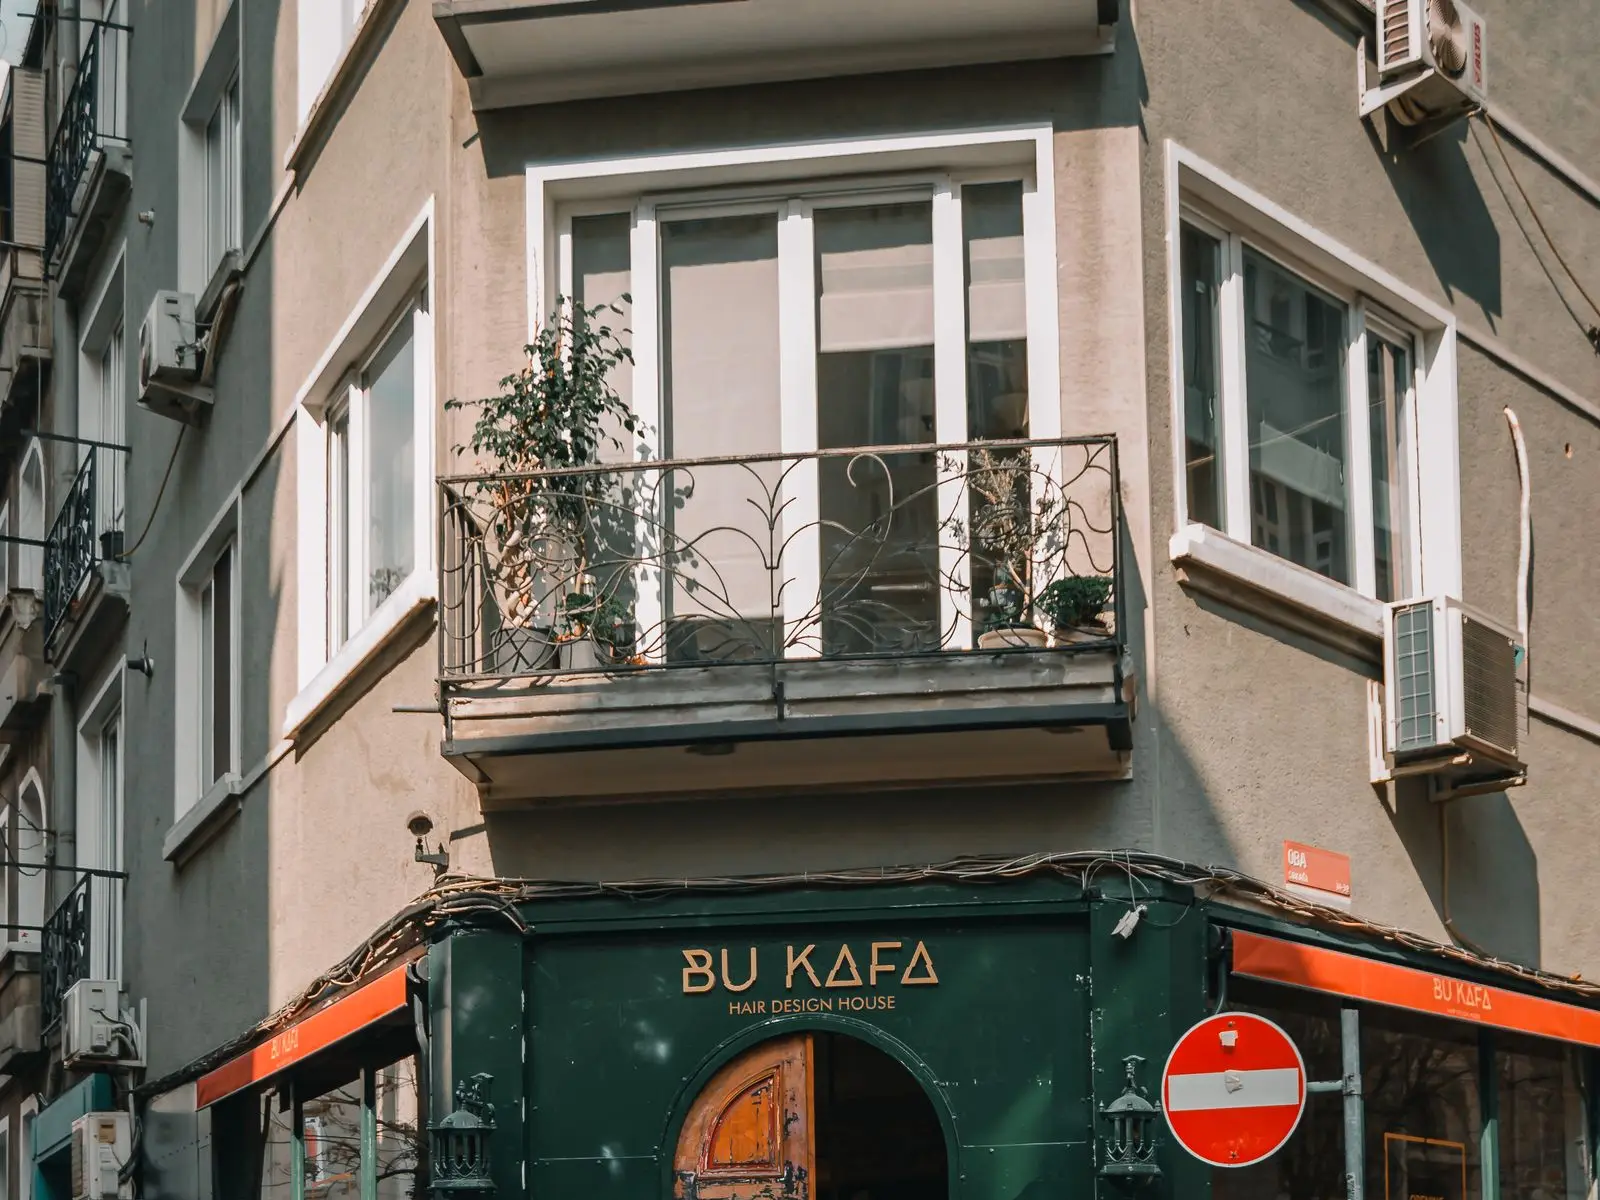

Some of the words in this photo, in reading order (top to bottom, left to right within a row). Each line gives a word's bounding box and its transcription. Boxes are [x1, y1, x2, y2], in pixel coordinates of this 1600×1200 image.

[1473, 22, 1482, 69] ALTUS
[1287, 849, 1307, 868] OBA
[682, 946, 758, 994] BU
[785, 940, 940, 989] KAFA
[729, 999, 766, 1015] HAIR
[771, 998, 833, 1014] DESIGN
[838, 995, 896, 1011] HOUSE
[1432, 977, 1453, 1002] BU
[1456, 982, 1492, 1010] KAFA
